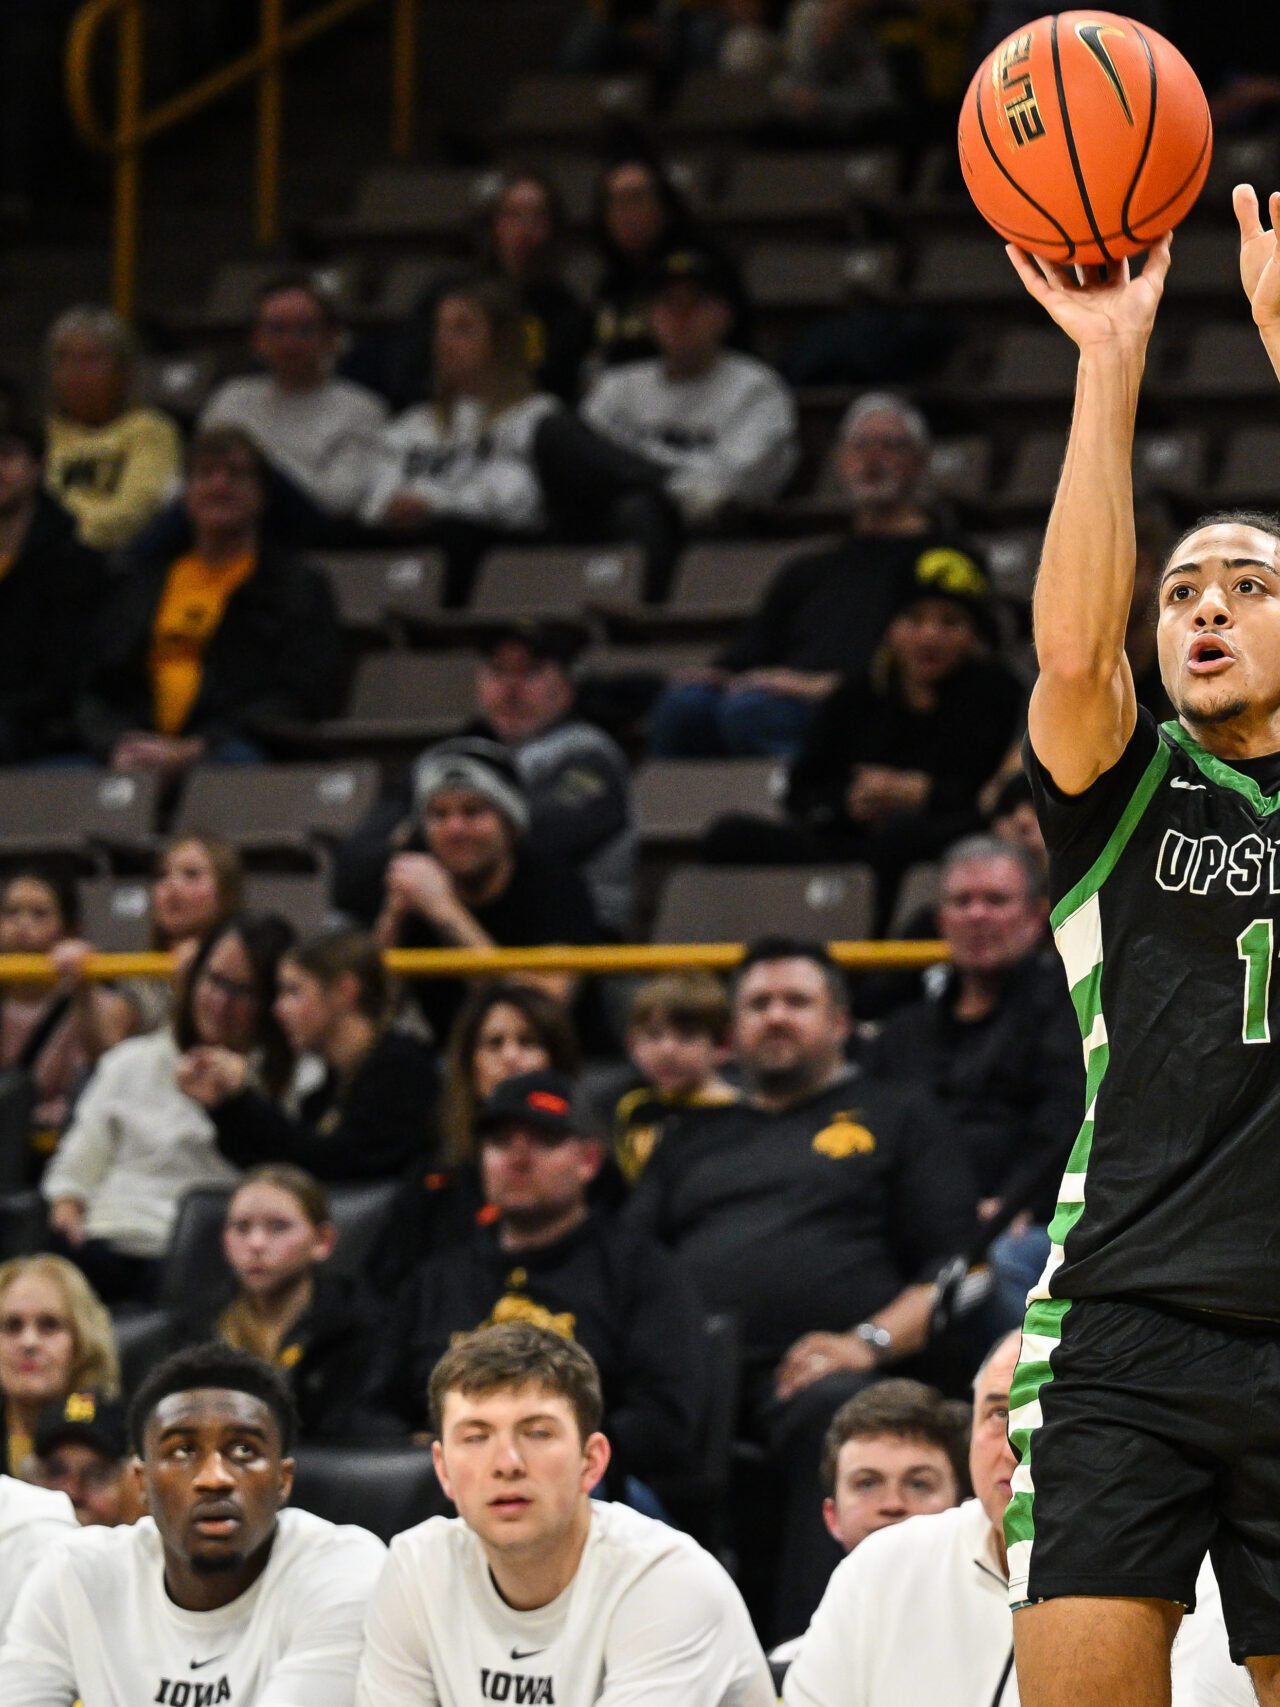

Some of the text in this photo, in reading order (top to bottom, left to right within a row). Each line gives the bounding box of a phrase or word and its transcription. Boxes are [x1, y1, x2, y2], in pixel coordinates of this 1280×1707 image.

[1001, 32, 1046, 147] ELITE
[154, 1674, 231, 1707] IOWA
[481, 1667, 556, 1705] IOWA
